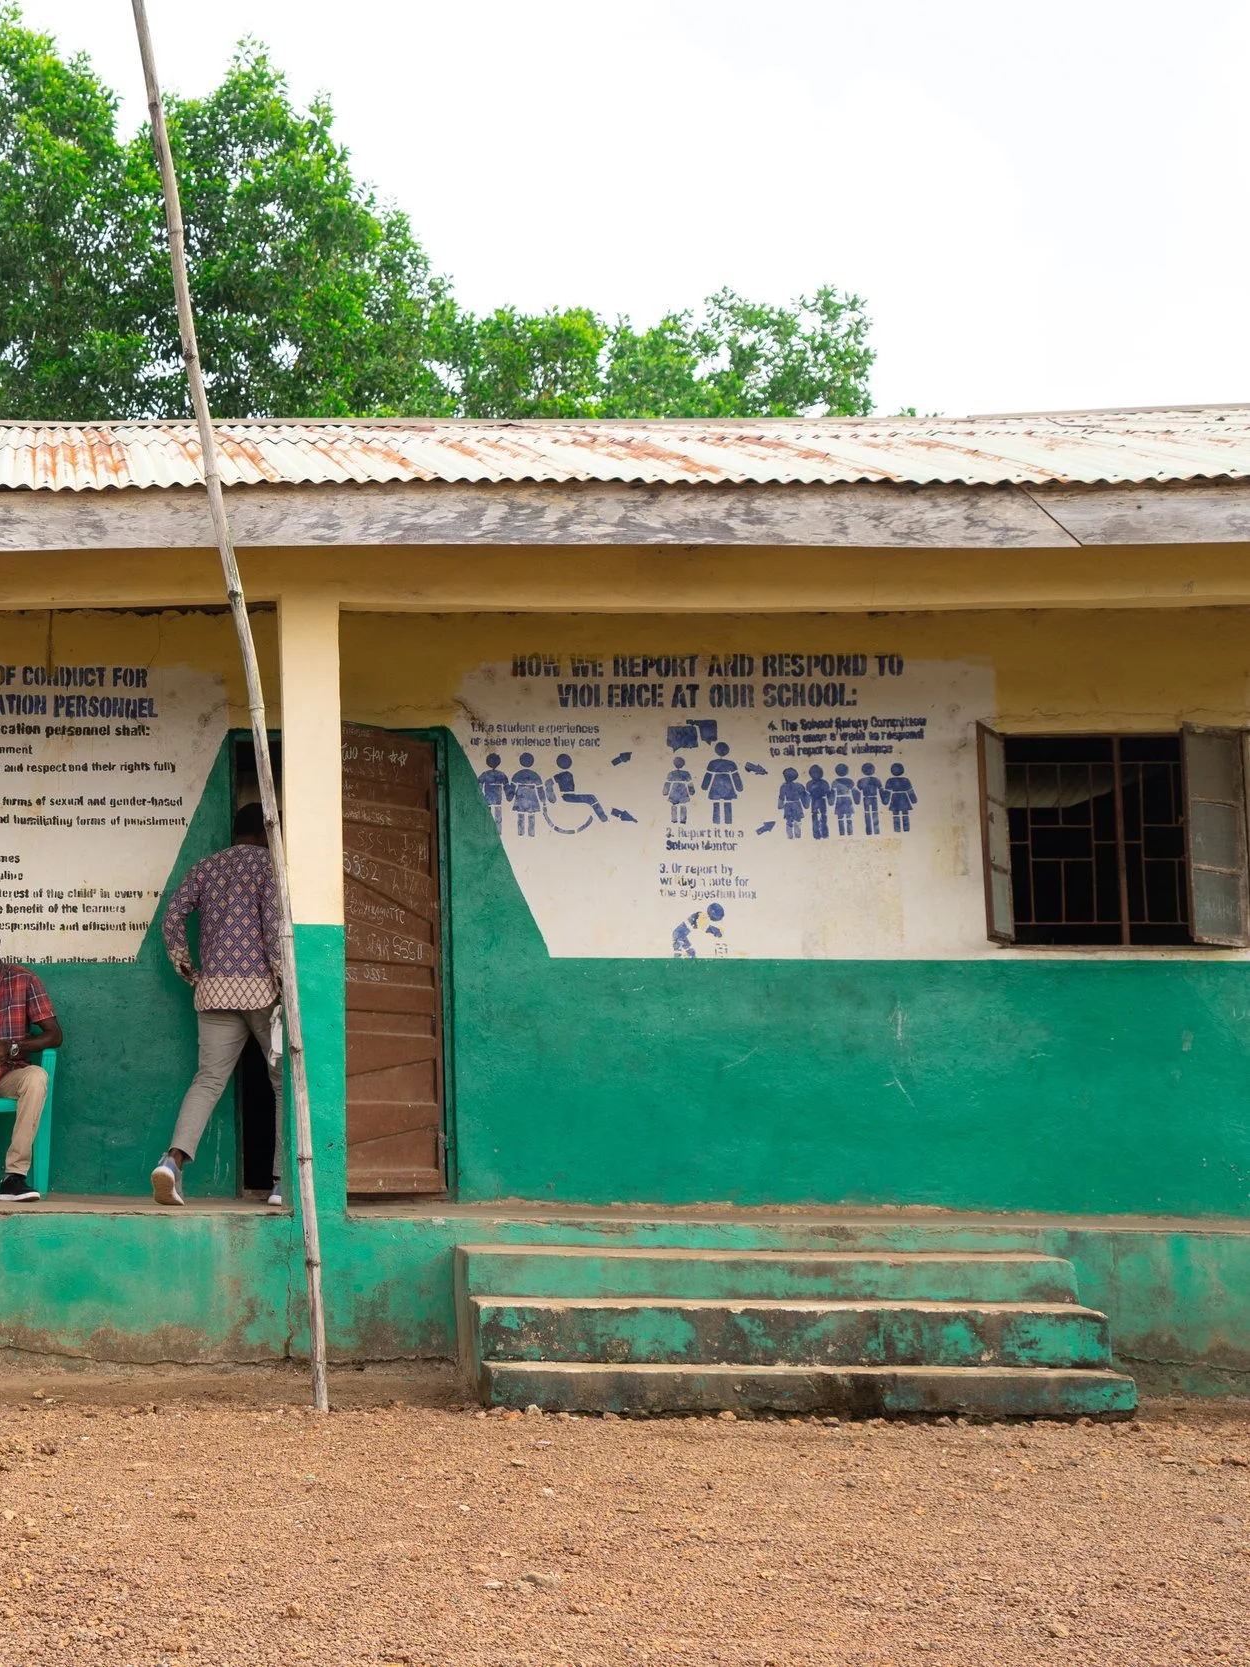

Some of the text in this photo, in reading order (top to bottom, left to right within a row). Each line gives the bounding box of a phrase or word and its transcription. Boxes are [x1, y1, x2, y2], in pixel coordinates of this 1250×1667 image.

[512, 652, 904, 677] HOW WE REPORT AND RESPOND TO
[22, 665, 107, 688] CONDUCT
[112, 667, 148, 688] FOR
[557, 682, 857, 708] VIOLENCE AT OUR SCHOOL:
[53, 695, 158, 718] PERSONNEL
[45, 724, 110, 738] personnel
[115, 724, 150, 737] shall:
[488, 721, 599, 735] a student experiences
[781, 719, 798, 731] The
[511, 736, 551, 747] violence
[554, 736, 575, 749] they
[4, 763, 23, 773] and
[26, 763, 67, 774] respect
[68, 763, 88, 772] and
[92, 762, 116, 772] their
[120, 762, 150, 774] rights
[154, 762, 176, 773] fully
[3, 797, 33, 807] forms
[36, 796, 46, 806] of
[50, 796, 83, 806] sexual
[88, 797, 106, 806] and
[110, 797, 183, 808] gender-based
[76, 816, 106, 826] forms
[111, 817, 121, 826] of
[714, 828, 721, 838] it
[725, 828, 734, 838] to
[685, 864, 733, 876] report by
[735, 876, 749, 886] for
[33, 888, 44, 898] of
[100, 889, 110, 899] in
[6, 904, 44, 914] benefit
[48, 904, 59, 914] of
[62, 904, 78, 914] the
[82, 904, 126, 914] learners
[59, 922, 79, 932] and
